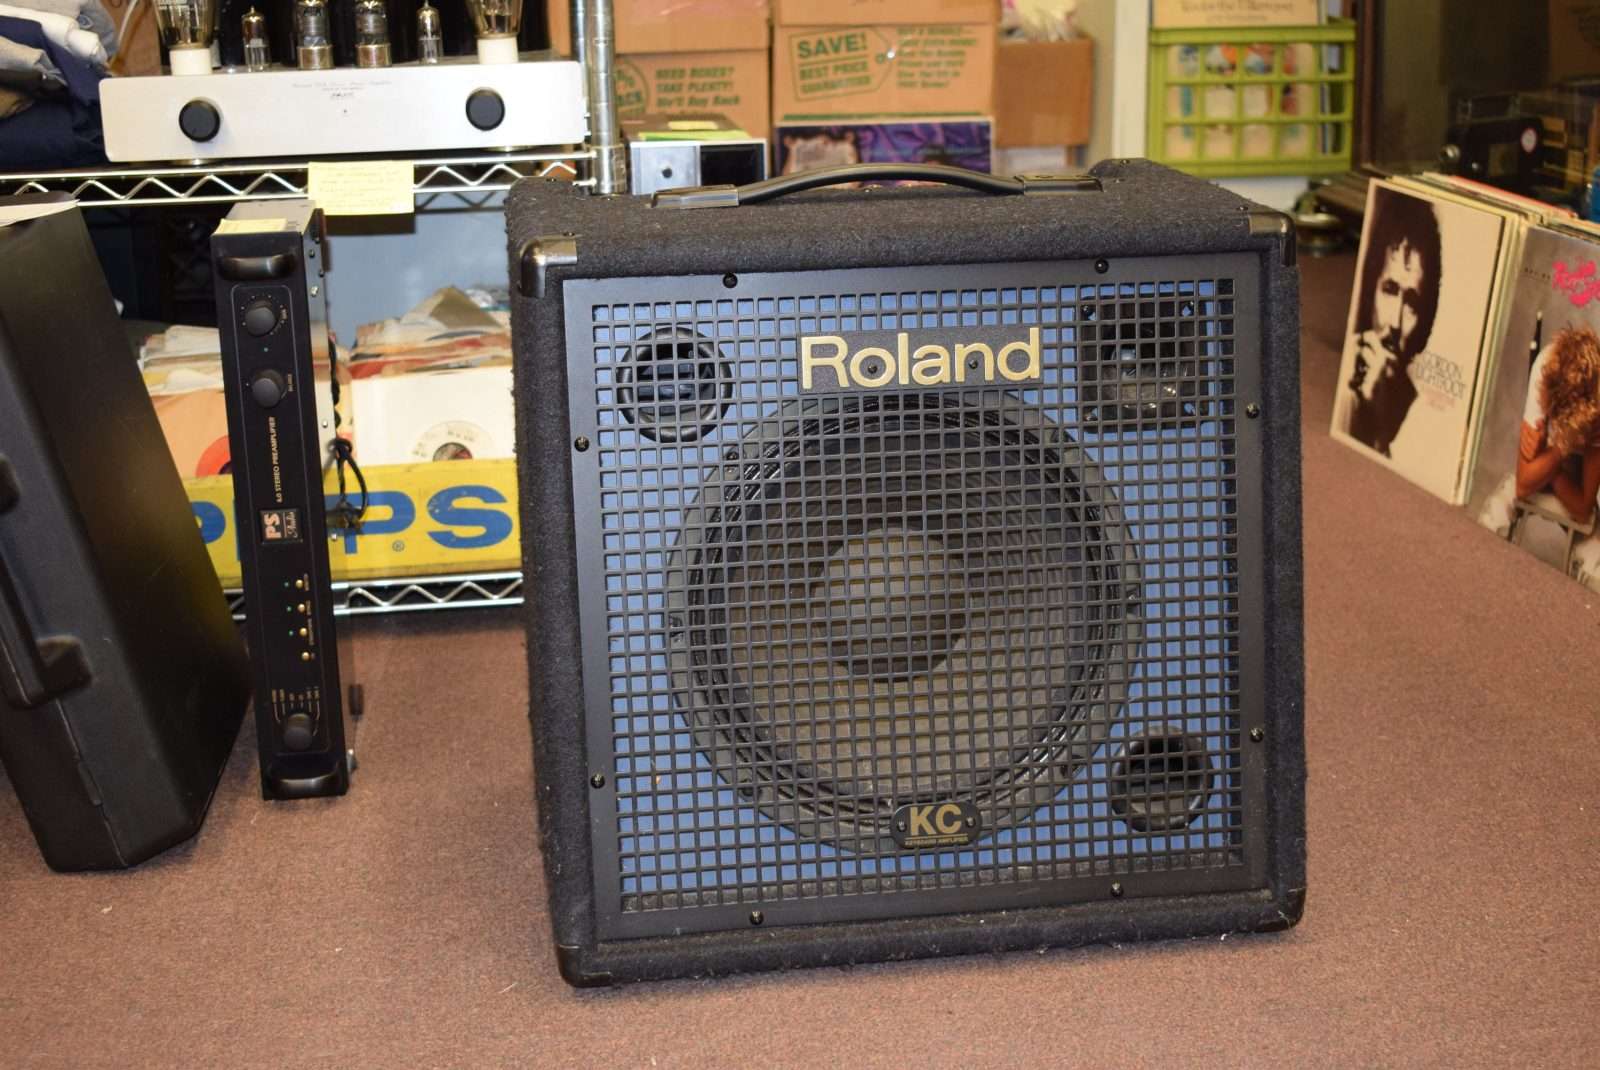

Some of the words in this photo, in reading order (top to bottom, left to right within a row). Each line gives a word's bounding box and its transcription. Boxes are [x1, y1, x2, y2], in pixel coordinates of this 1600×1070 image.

[798, 32, 867, 58] SAVE!
[655, 68, 686, 79] NEED
[799, 66, 828, 80] BEST
[832, 61, 867, 74] PRICE
[800, 327, 1041, 390] Roland
[268, 416, 279, 464] PREAMPLIFIER
[273, 466, 282, 492] STEREO
[263, 512, 282, 539] PS
[910, 804, 961, 836] KC
